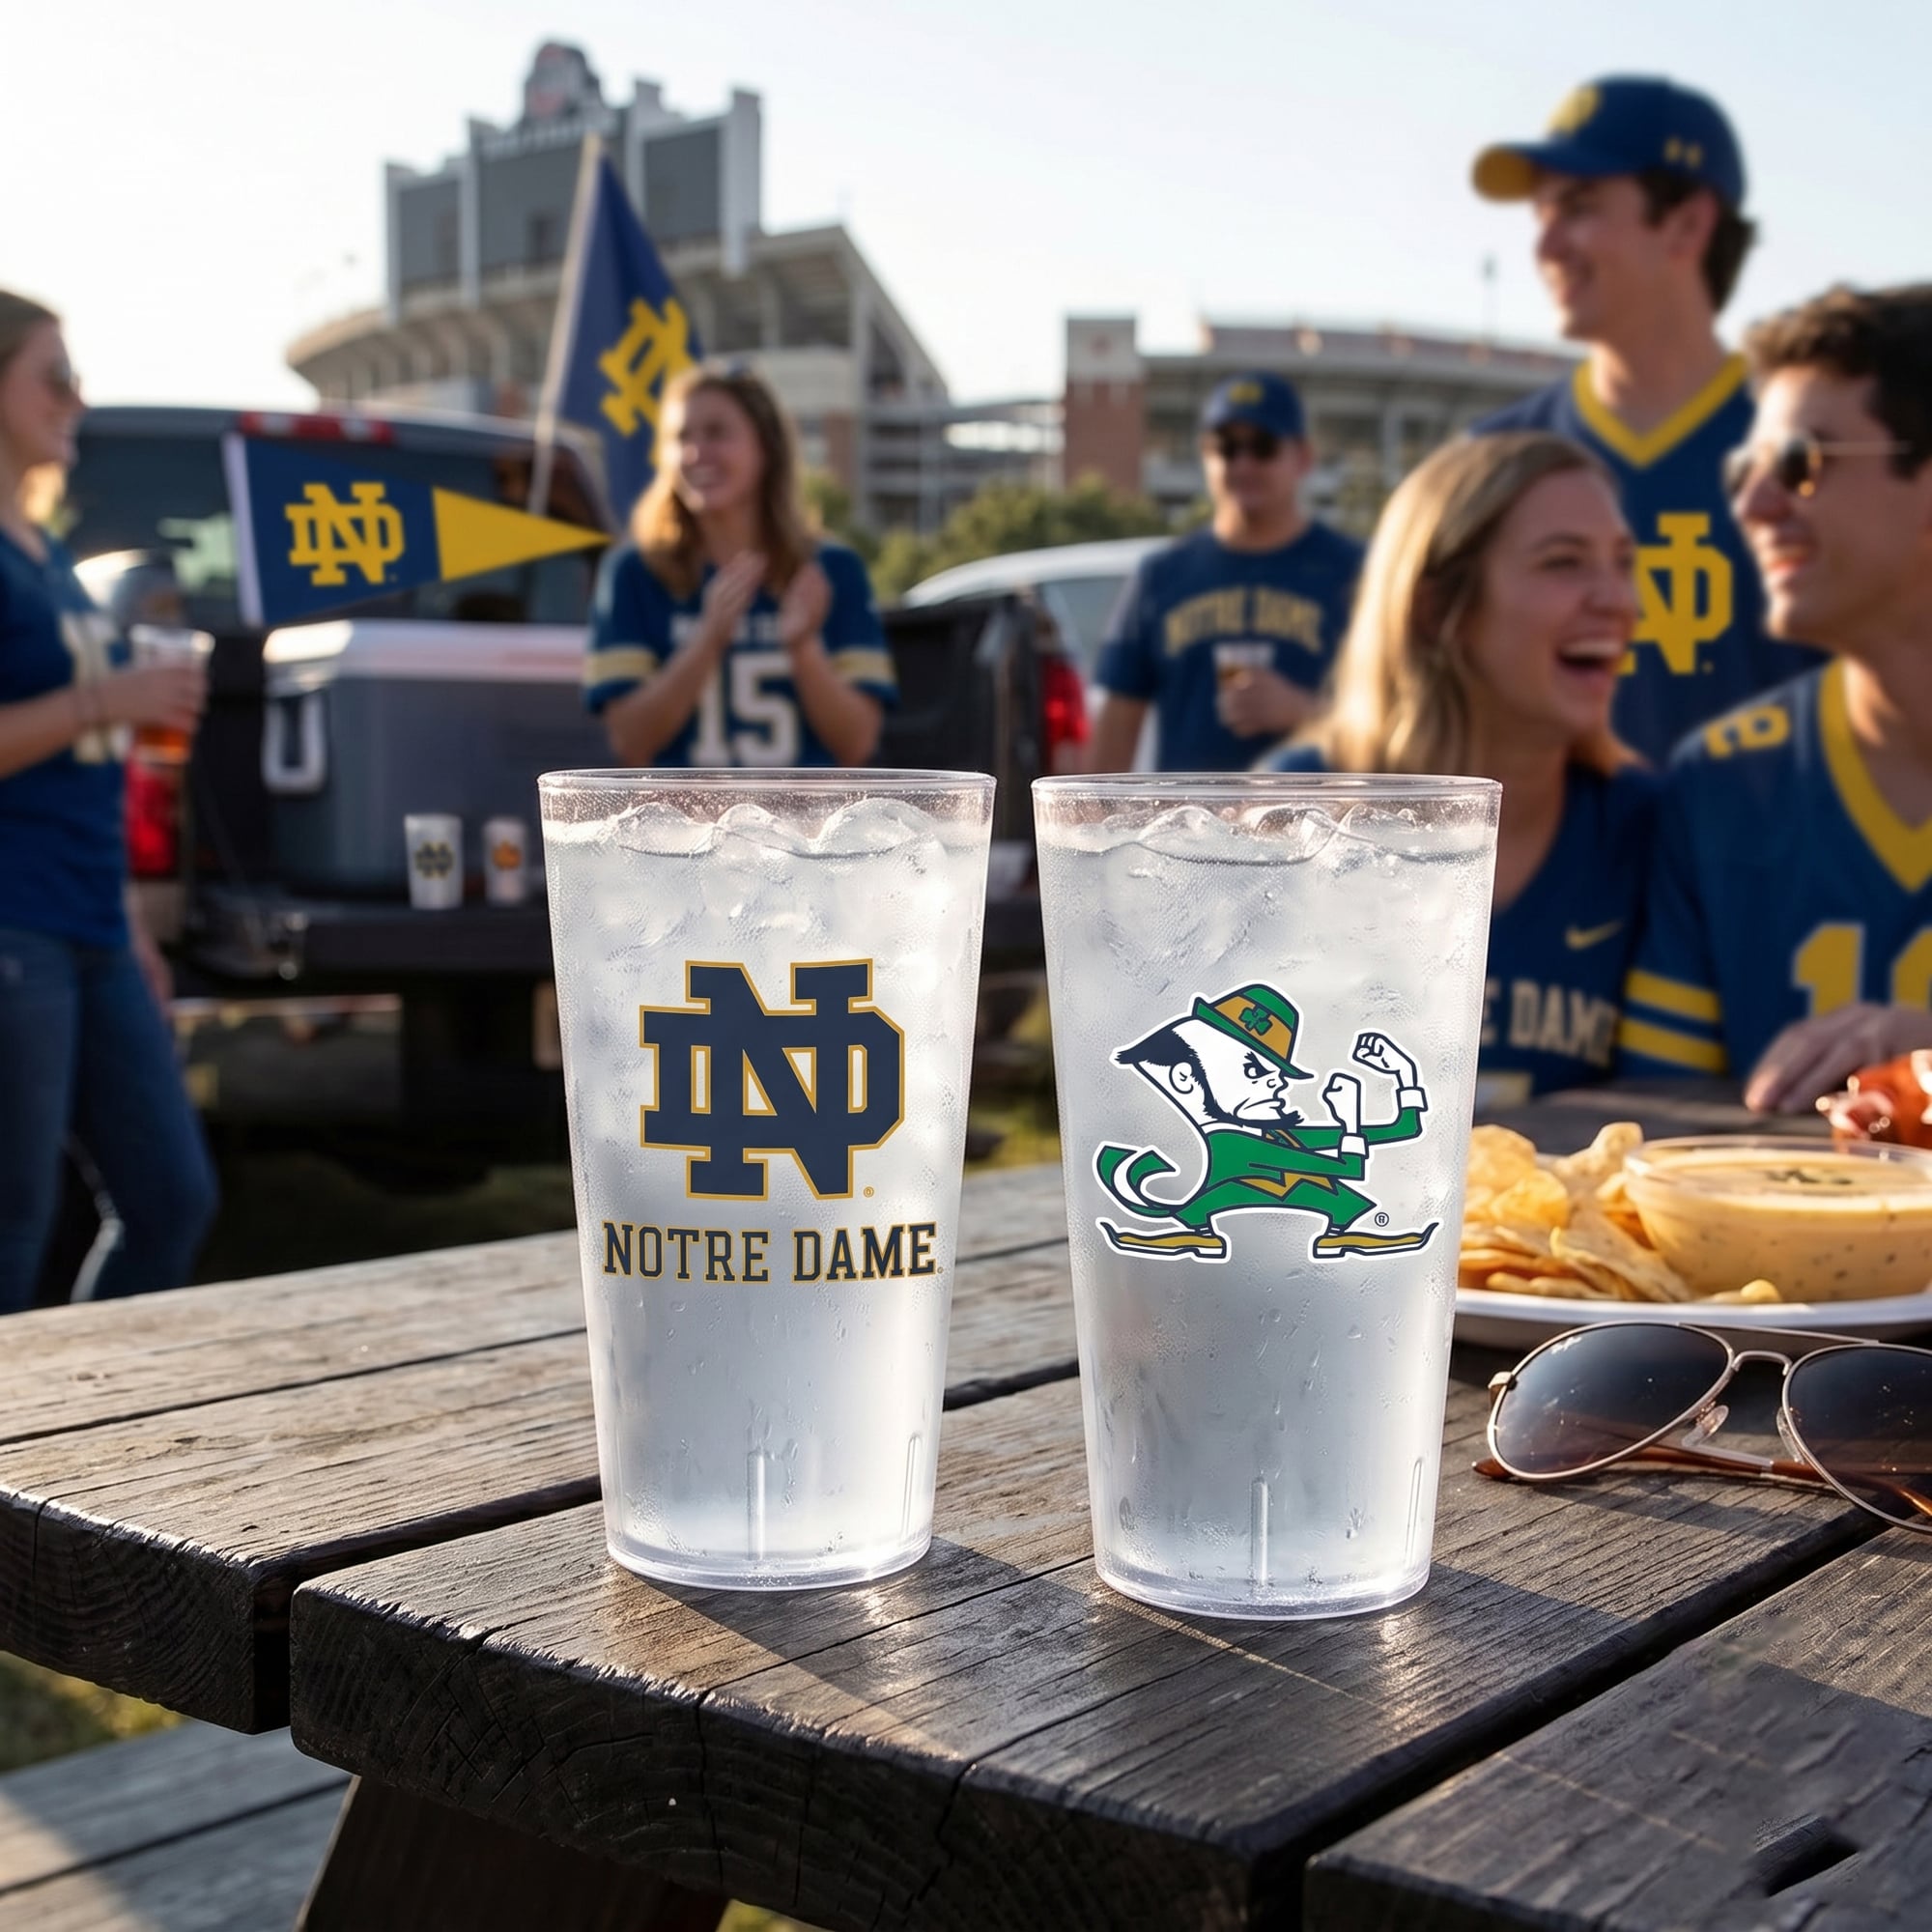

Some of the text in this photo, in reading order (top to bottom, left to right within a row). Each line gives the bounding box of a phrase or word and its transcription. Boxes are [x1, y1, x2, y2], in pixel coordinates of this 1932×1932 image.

[284, 481, 405, 586] ND
[688, 652, 801, 768] 15
[639, 958, 905, 1201] ND
[602, 1221, 937, 1284] NOTRE DAME
